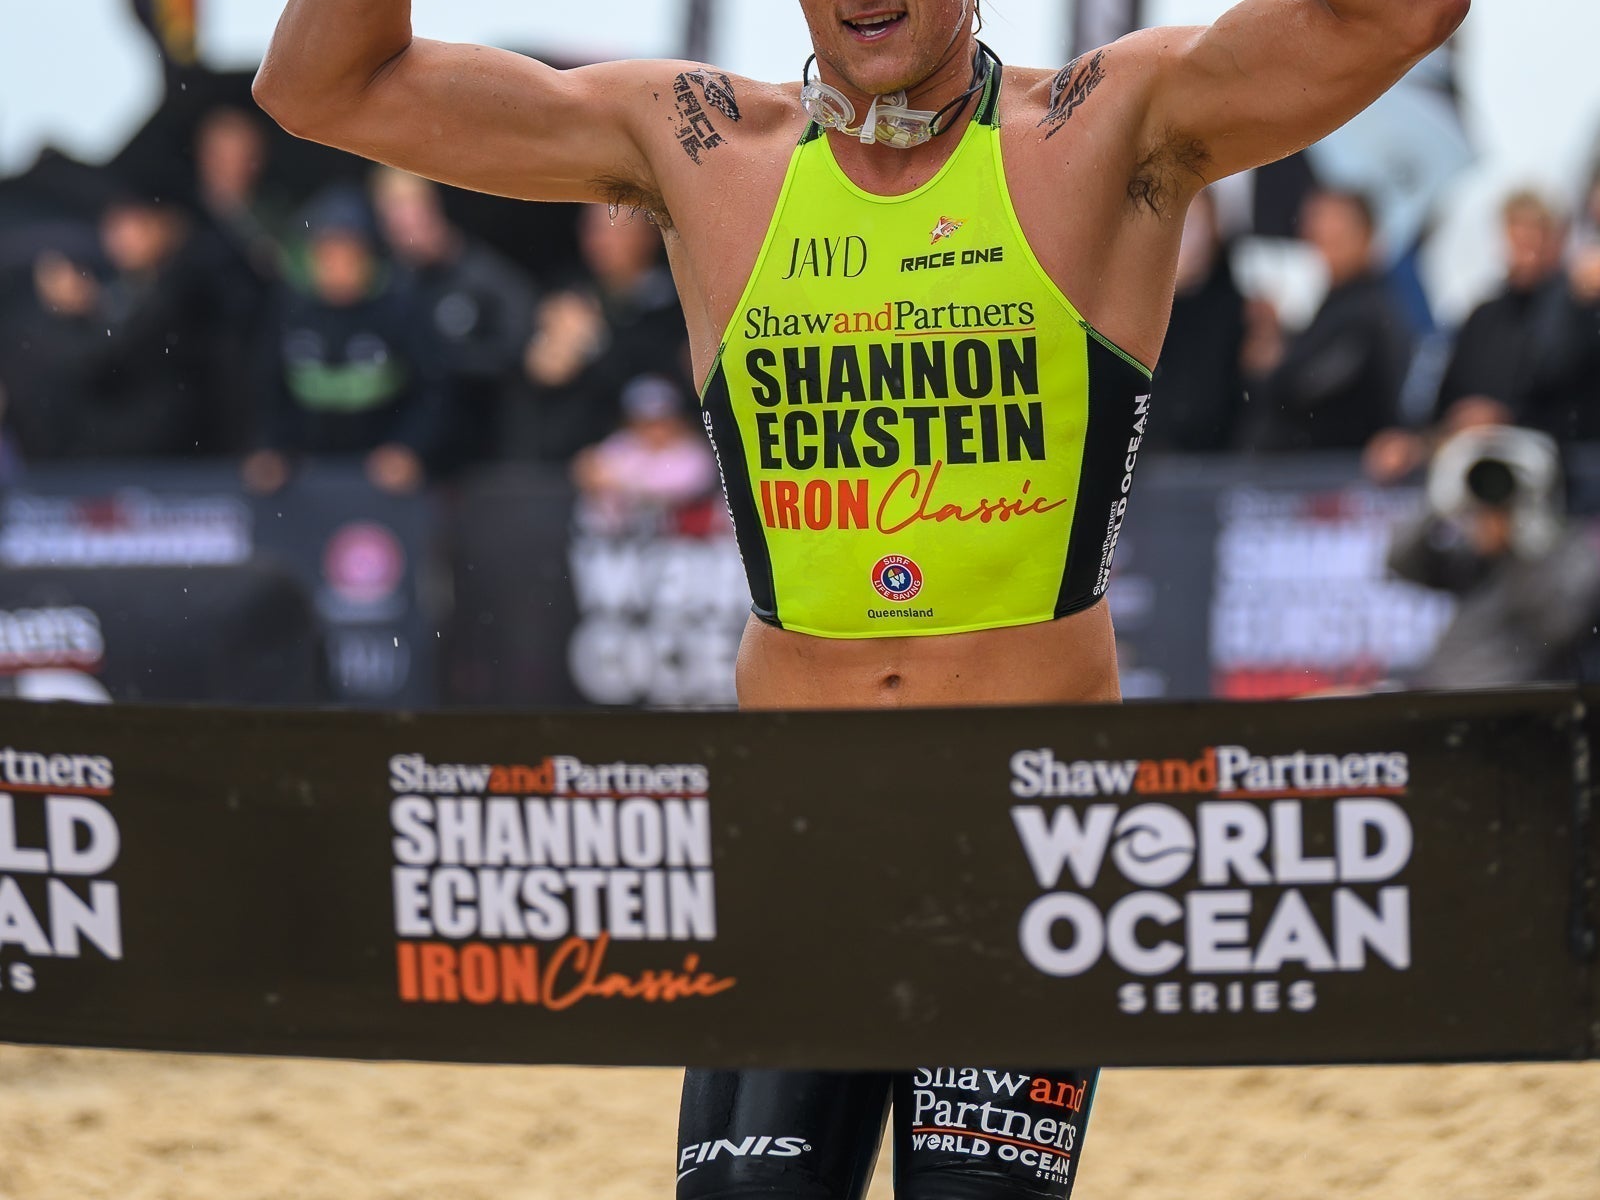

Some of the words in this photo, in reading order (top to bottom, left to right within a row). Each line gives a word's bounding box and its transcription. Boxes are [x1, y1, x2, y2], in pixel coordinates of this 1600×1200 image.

[782, 235, 868, 280] JAYD
[900, 251, 956, 273] RACE
[961, 246, 1004, 265] ONE
[745, 336, 1039, 408] SHANNON
[755, 402, 1046, 471] ECKSTEIN
[760, 479, 870, 531] IRON
[875, 460, 1067, 536] Classic
[874, 580, 891, 597] LIFE
[893, 580, 921, 600] SAVING
[883, 556, 911, 566] SURF
[867, 607, 934, 619] Queensland
[390, 795, 712, 866] SHANNON
[1010, 797, 1413, 889] WORLD
[393, 865, 717, 940] ECKSTEIN
[1018, 886, 1411, 977] OCEAN
[396, 941, 540, 1004] IRON
[543, 931, 737, 1011] Classic
[1118, 981, 1317, 1014] SERIES
[912, 1090, 1077, 1151] Partners
[912, 1133, 991, 1156] WORLD
[998, 1144, 1070, 1176] OCEAN
[1036, 1170, 1068, 1185] SERIES
